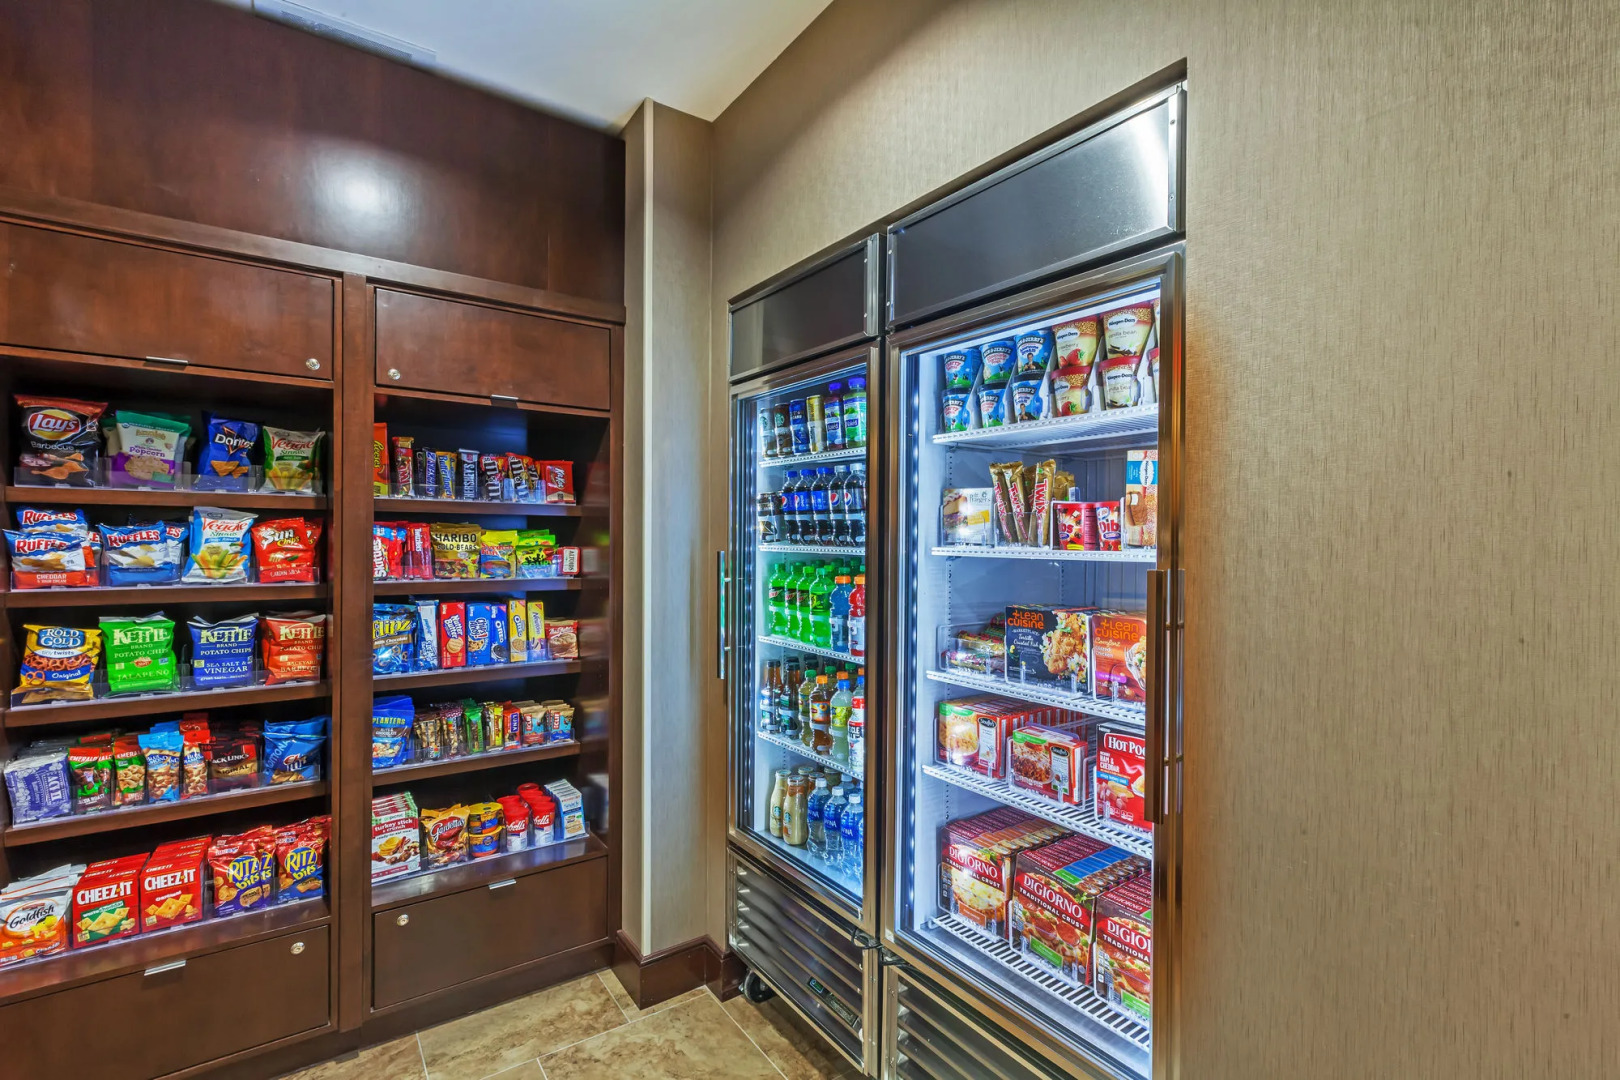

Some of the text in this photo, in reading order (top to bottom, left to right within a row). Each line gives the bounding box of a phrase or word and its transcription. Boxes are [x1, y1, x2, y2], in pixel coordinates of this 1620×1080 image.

[30, 440, 75, 452] Barbecue
[129, 446, 166, 458] Popcorn
[1100, 519, 1120, 533] Dib
[107, 530, 160, 547] RUFFLES
[260, 529, 294, 550] Sun
[435, 533, 477, 543] HARIBO
[36, 573, 67, 581] CHEDDAR
[47, 628, 79, 638] ROLD
[113, 627, 173, 646] KETTLE
[200, 627, 253, 644] KETTLE
[280, 624, 325, 641] KETTLE
[40, 637, 82, 647] GOLD
[114, 651, 146, 659] POTATO
[52, 669, 82, 680] Original
[204, 665, 249, 675] VINEGAR
[1107, 736, 1127, 752] HOT
[375, 818, 413, 832] turkey stick
[227, 855, 260, 883] RITZ
[286, 849, 315, 873] RITZ
[292, 864, 318, 880] bits
[235, 872, 261, 890] bits
[981, 877, 1001, 889] CRUST
[1024, 874, 1083, 919] DIGIORNO
[9, 904, 55, 929] Goldfish
[1019, 888, 1085, 930] TRADITIONAL CRUST
